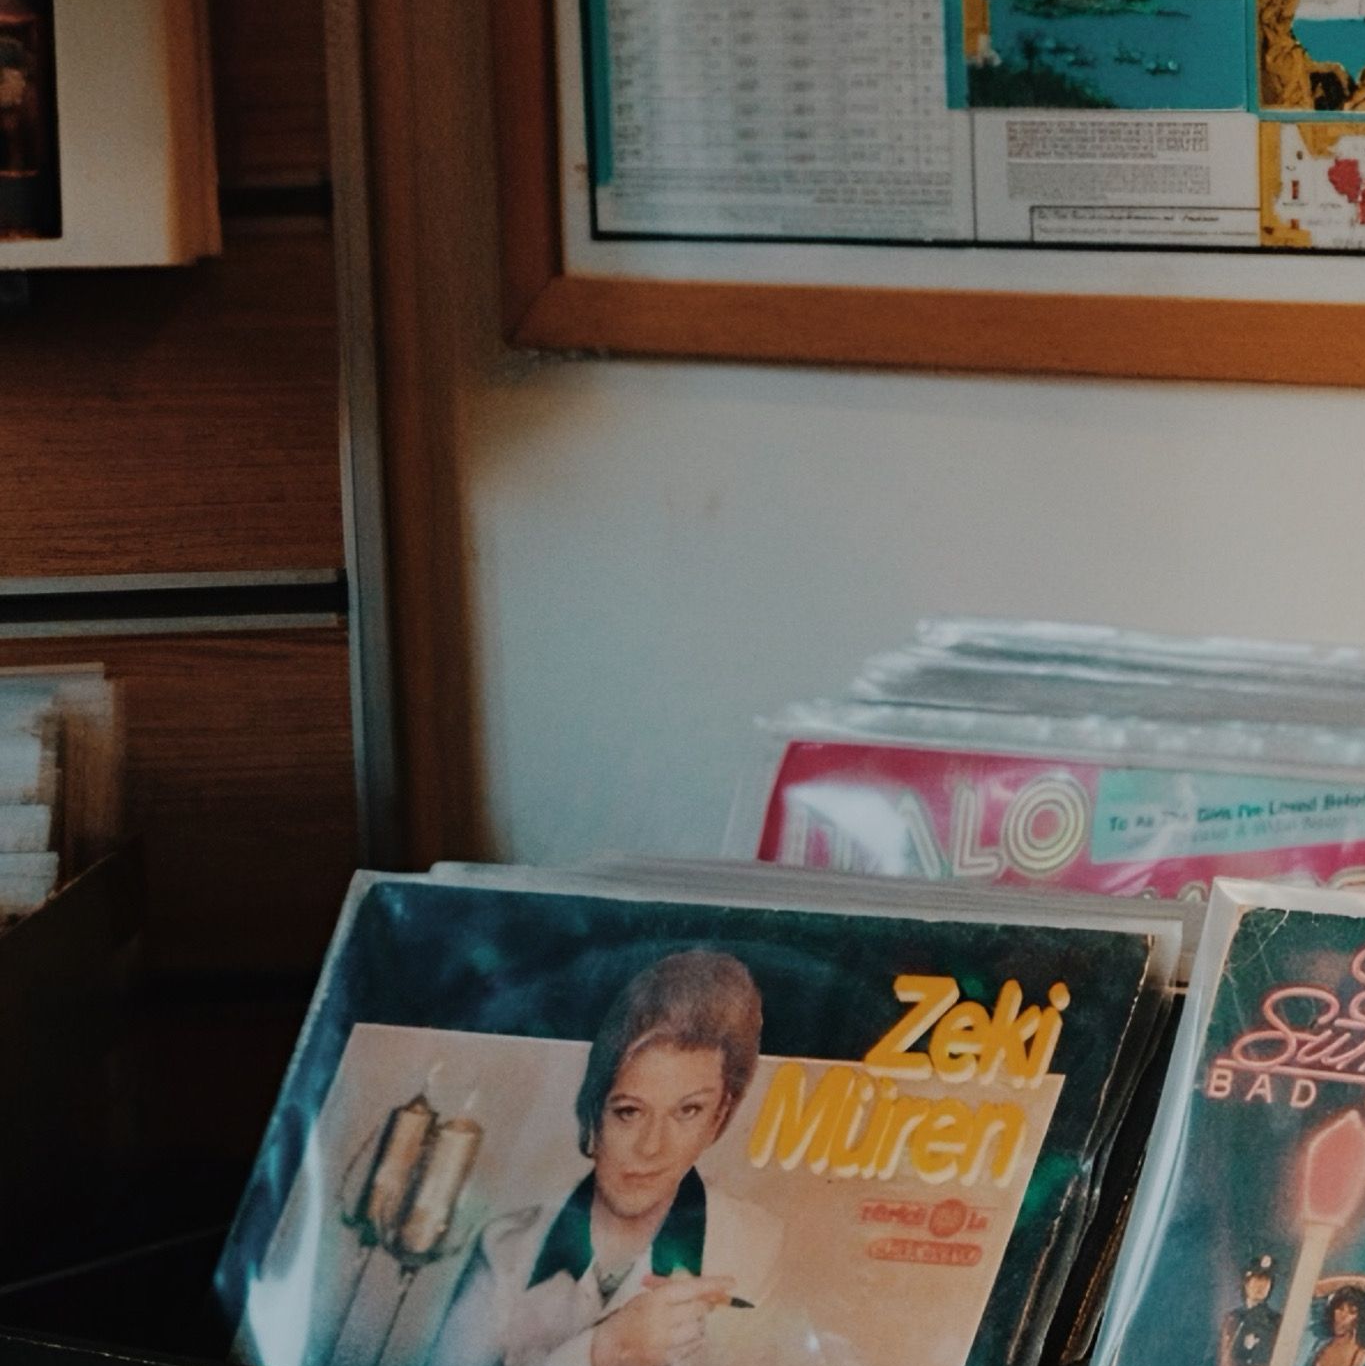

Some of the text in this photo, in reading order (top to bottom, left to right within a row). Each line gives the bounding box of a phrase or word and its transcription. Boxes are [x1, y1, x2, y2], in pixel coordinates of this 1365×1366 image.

[864, 973, 1071, 1090] Zeki
[1205, 1067, 1319, 1110] BAD
[748, 1061, 1027, 1189] Müren
